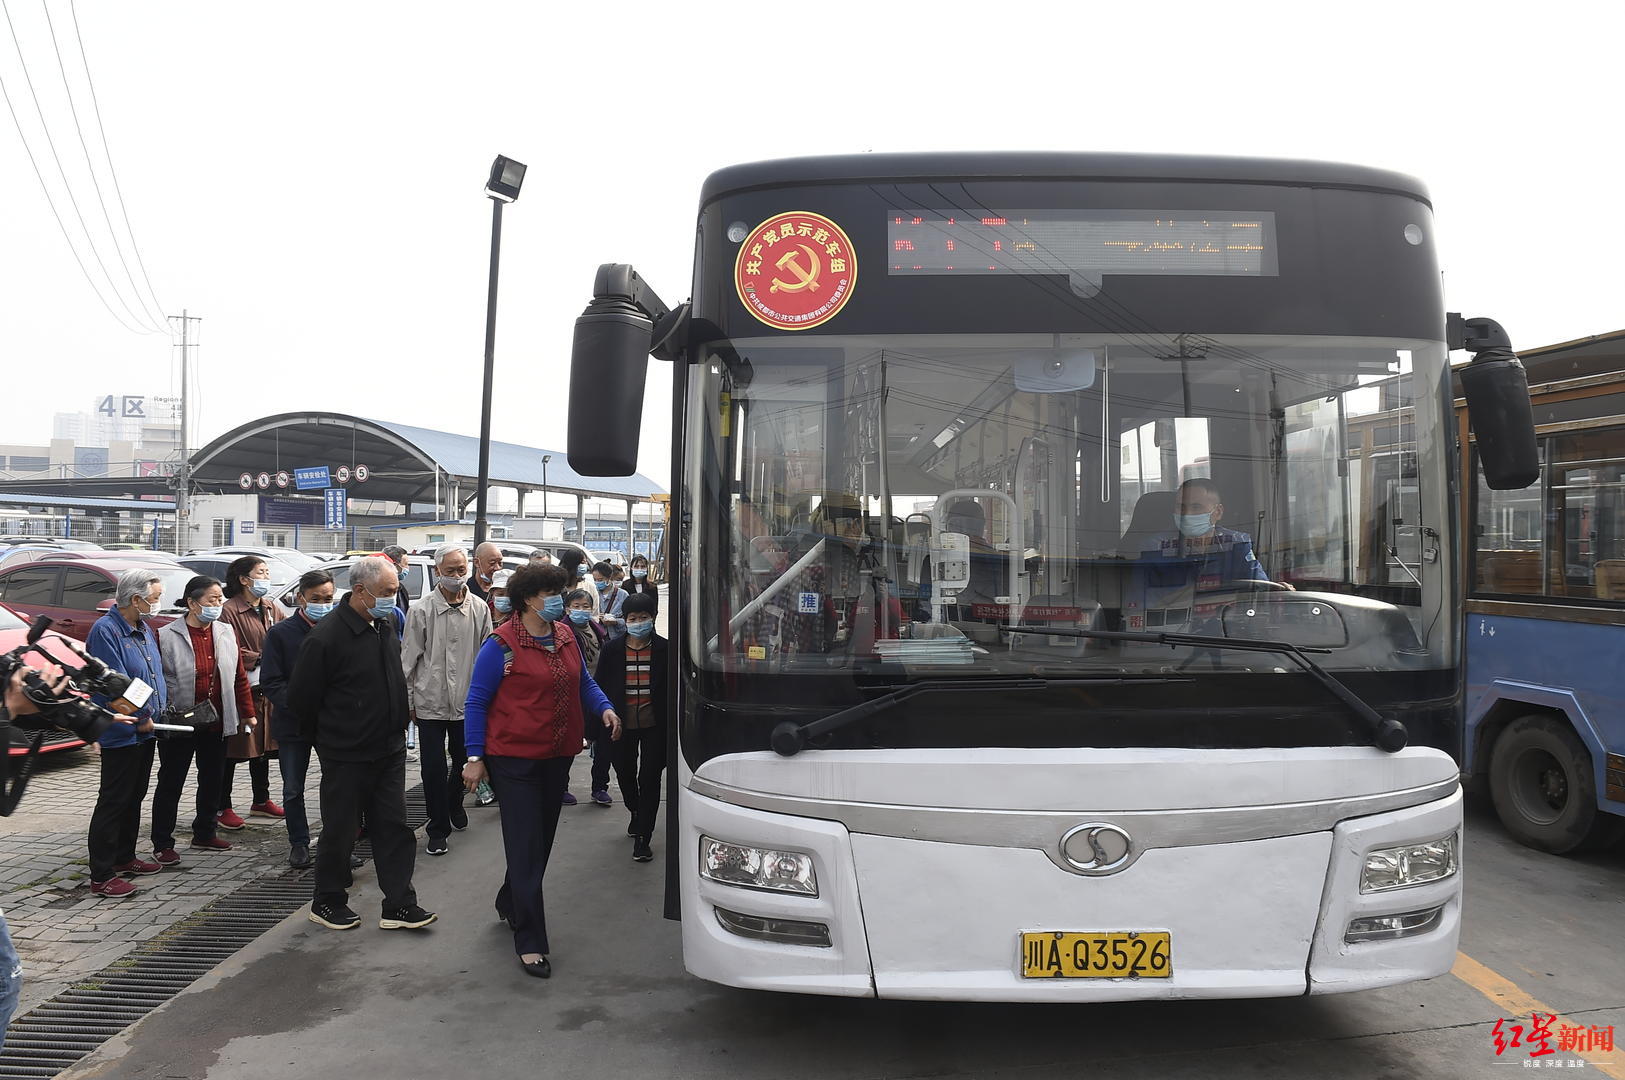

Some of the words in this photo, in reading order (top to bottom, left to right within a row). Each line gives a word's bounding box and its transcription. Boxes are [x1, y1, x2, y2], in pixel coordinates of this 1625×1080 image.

[746, 223, 845, 275] 共产党员示范车组
[359, 469, 365, 477] 5
[801, 594, 816, 608] 推
